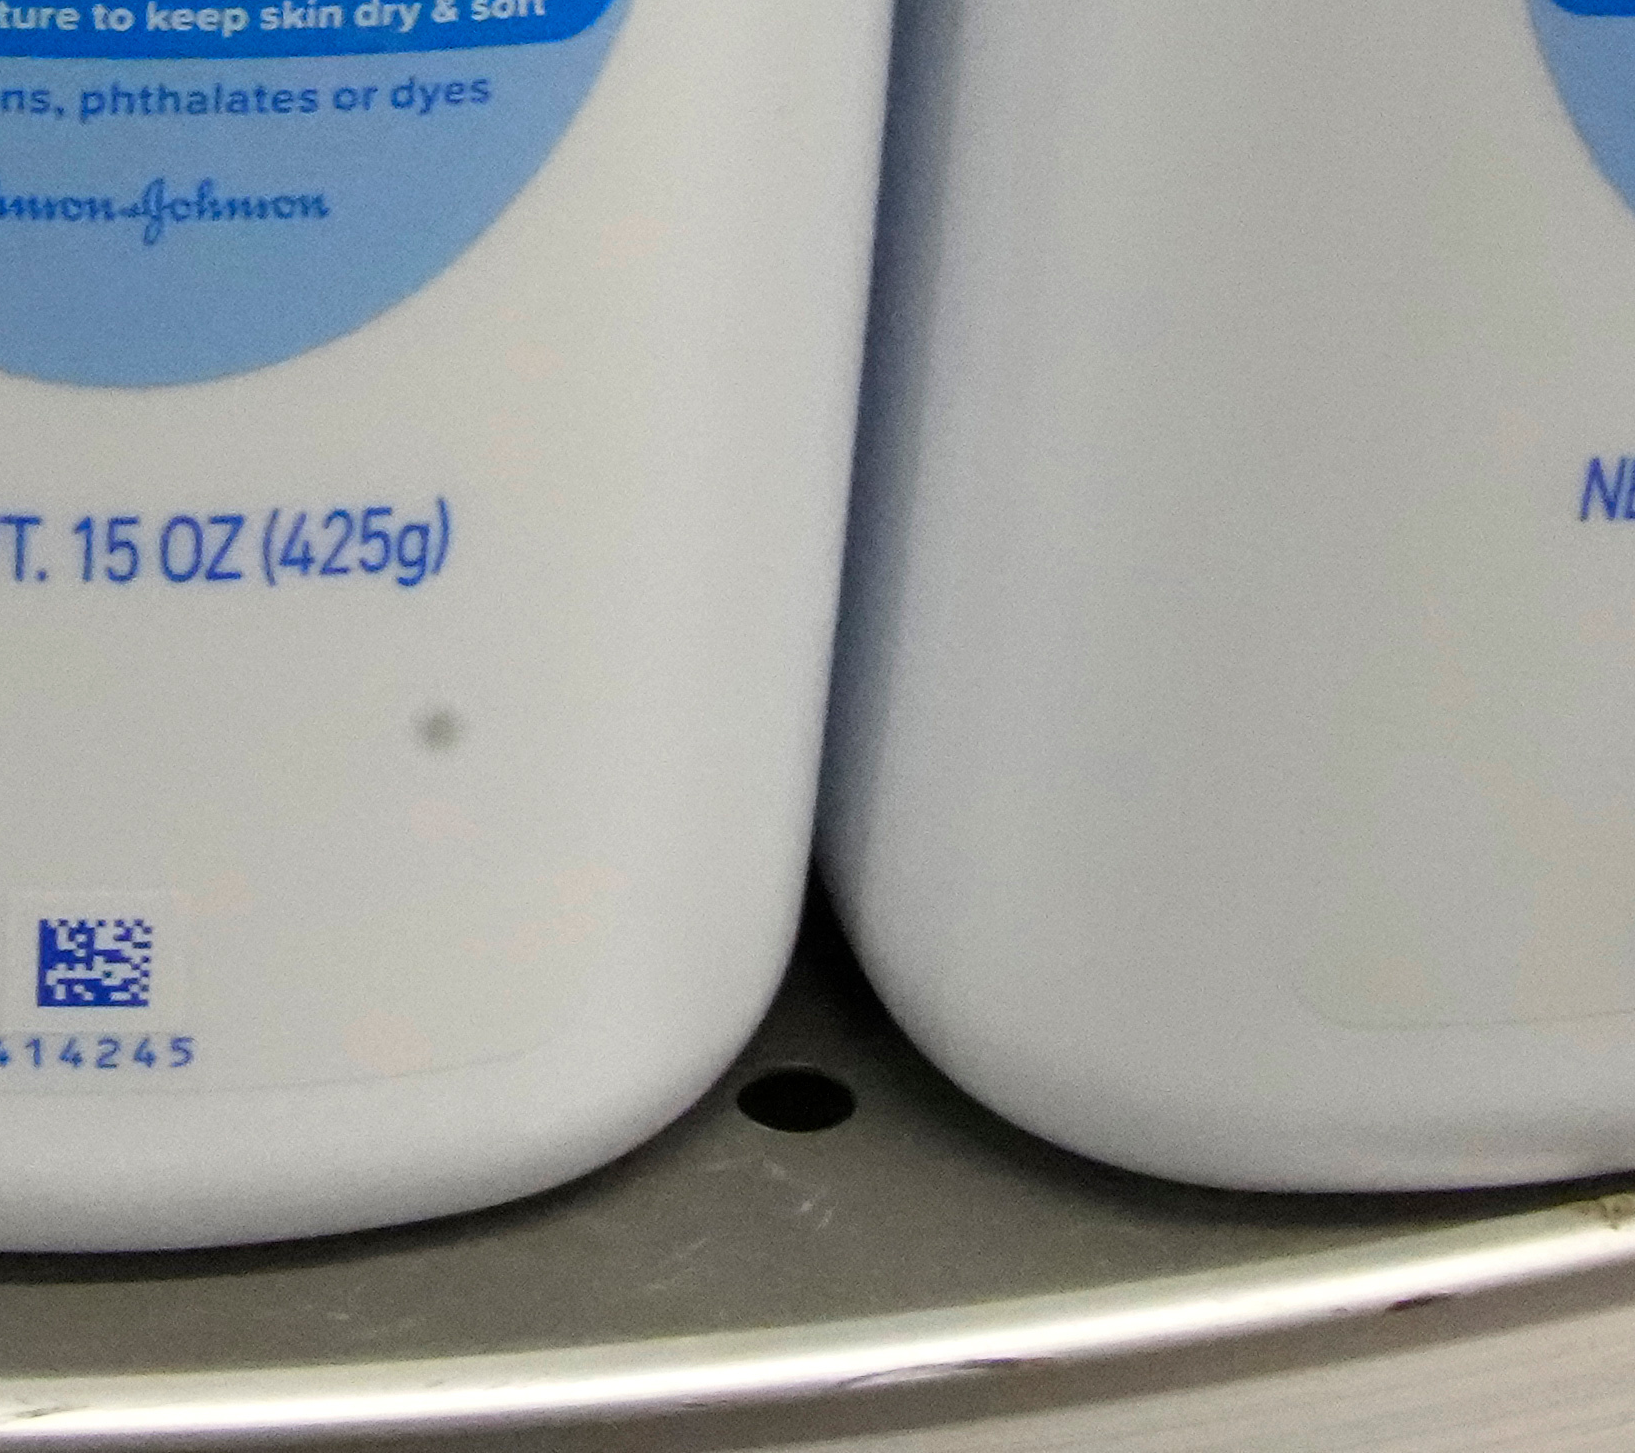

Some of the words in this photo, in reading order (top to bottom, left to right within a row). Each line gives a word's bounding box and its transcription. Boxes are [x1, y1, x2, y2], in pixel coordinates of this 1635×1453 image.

[92, 0, 133, 32] to
[78, 81, 319, 123] phthalates
[389, 74, 492, 115] dyes
[73, 515, 141, 584] 15
[160, 514, 245, 583] OZ
[261, 497, 452, 588] (425g)
